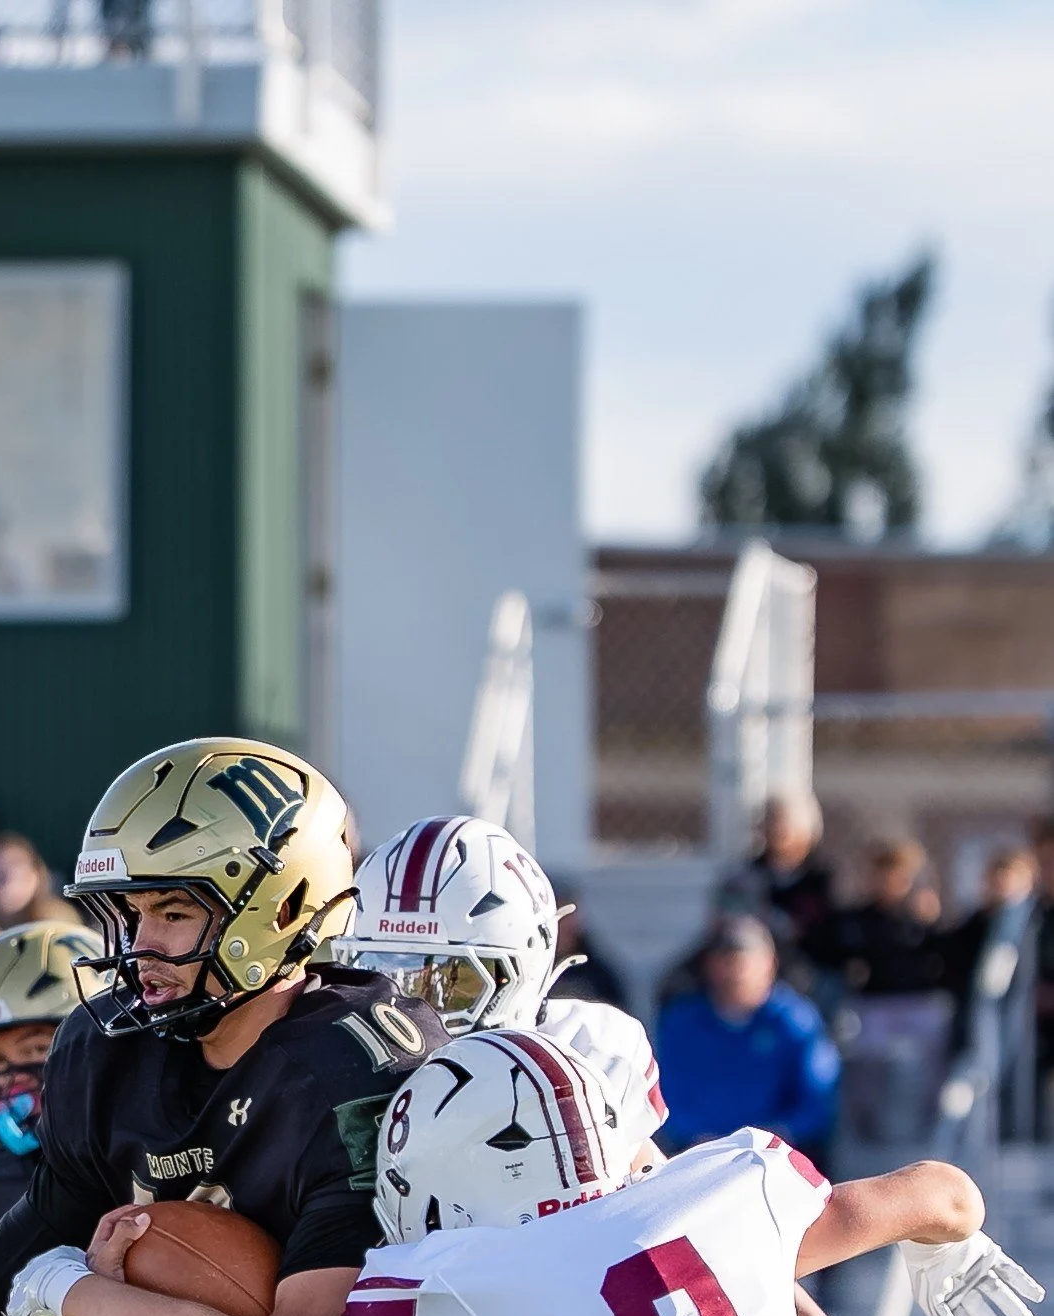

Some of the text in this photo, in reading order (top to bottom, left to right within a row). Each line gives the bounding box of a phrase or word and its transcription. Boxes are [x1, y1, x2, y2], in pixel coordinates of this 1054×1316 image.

[77, 856, 116, 874] Riddell
[378, 919, 439, 935] Riddell
[332, 1002, 427, 1073] 10
[387, 1088, 413, 1155] 8
[145, 1147, 214, 1179] MONTE
